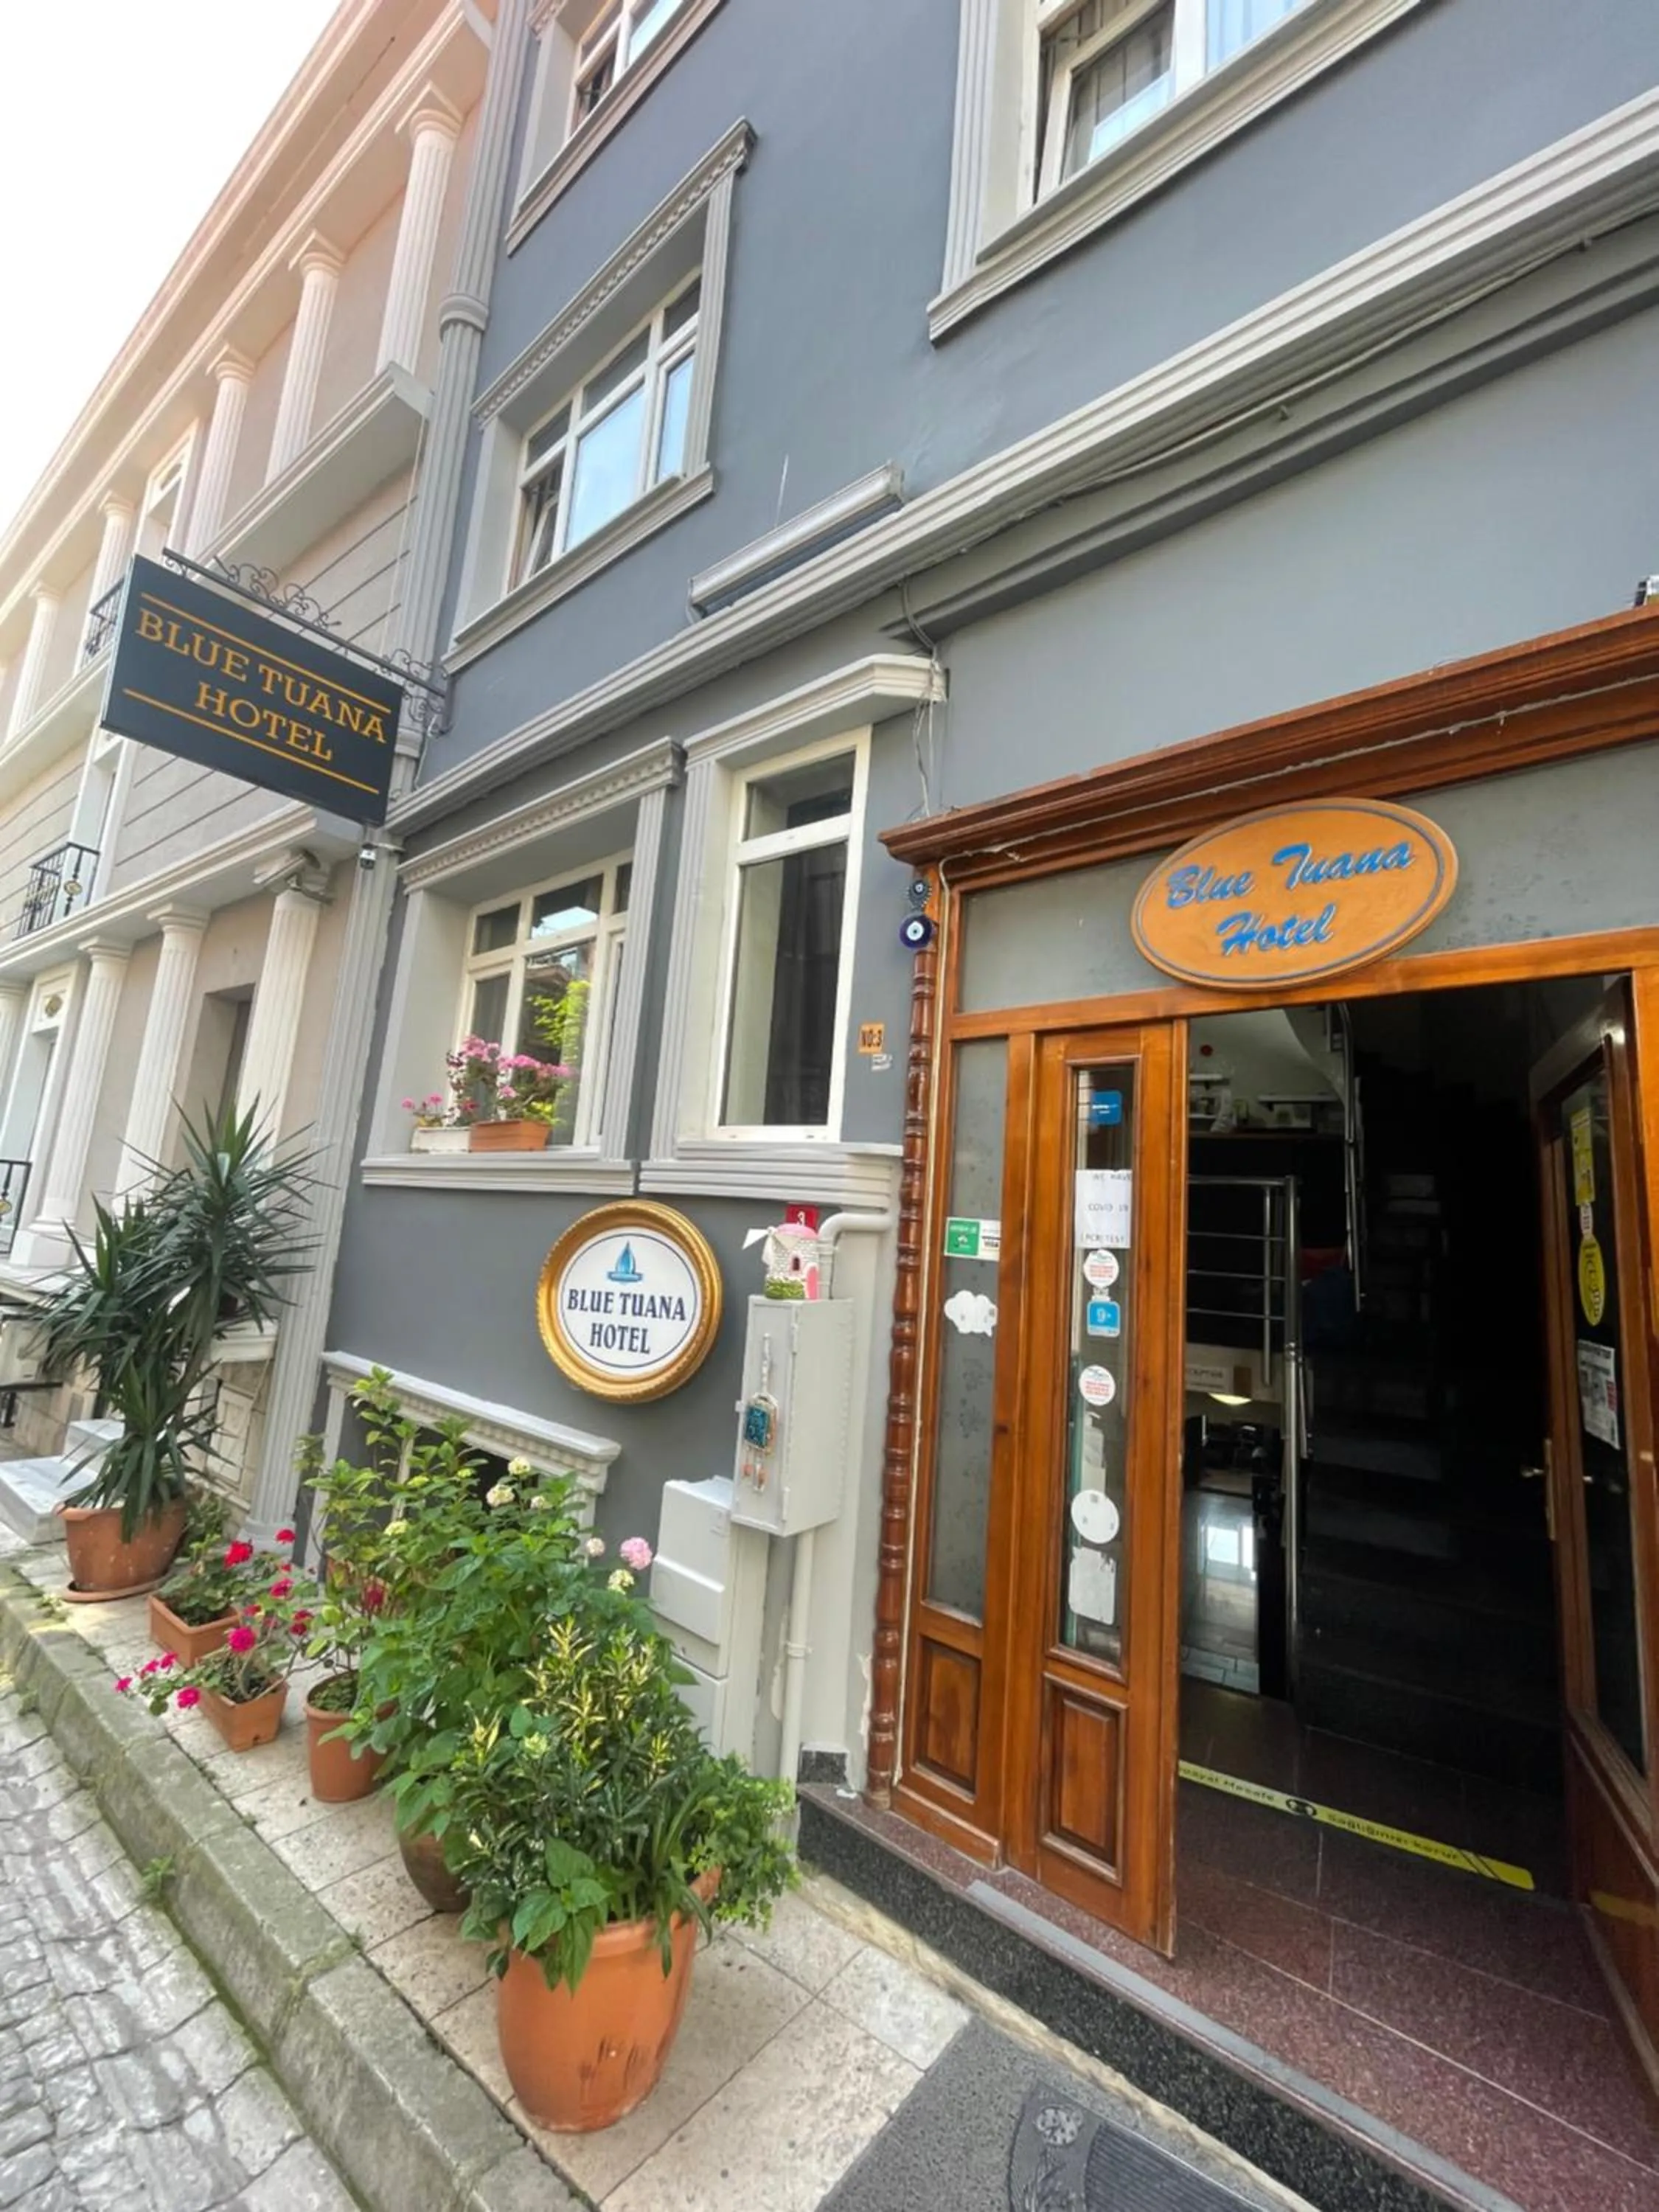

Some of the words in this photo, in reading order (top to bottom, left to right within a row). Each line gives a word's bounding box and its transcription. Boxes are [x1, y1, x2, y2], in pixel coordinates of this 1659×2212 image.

[136, 609, 250, 683] BLUE
[258, 664, 387, 744] TUANA
[195, 681, 333, 762] HOTEL
[1166, 865, 1255, 909] Blue
[1272, 841, 1416, 890] Tuana
[1216, 904, 1338, 956] Hotel
[567, 1289, 614, 1315] BLUE
[619, 1292, 686, 1321] TUANA
[589, 1322, 650, 1354] HOTEL
